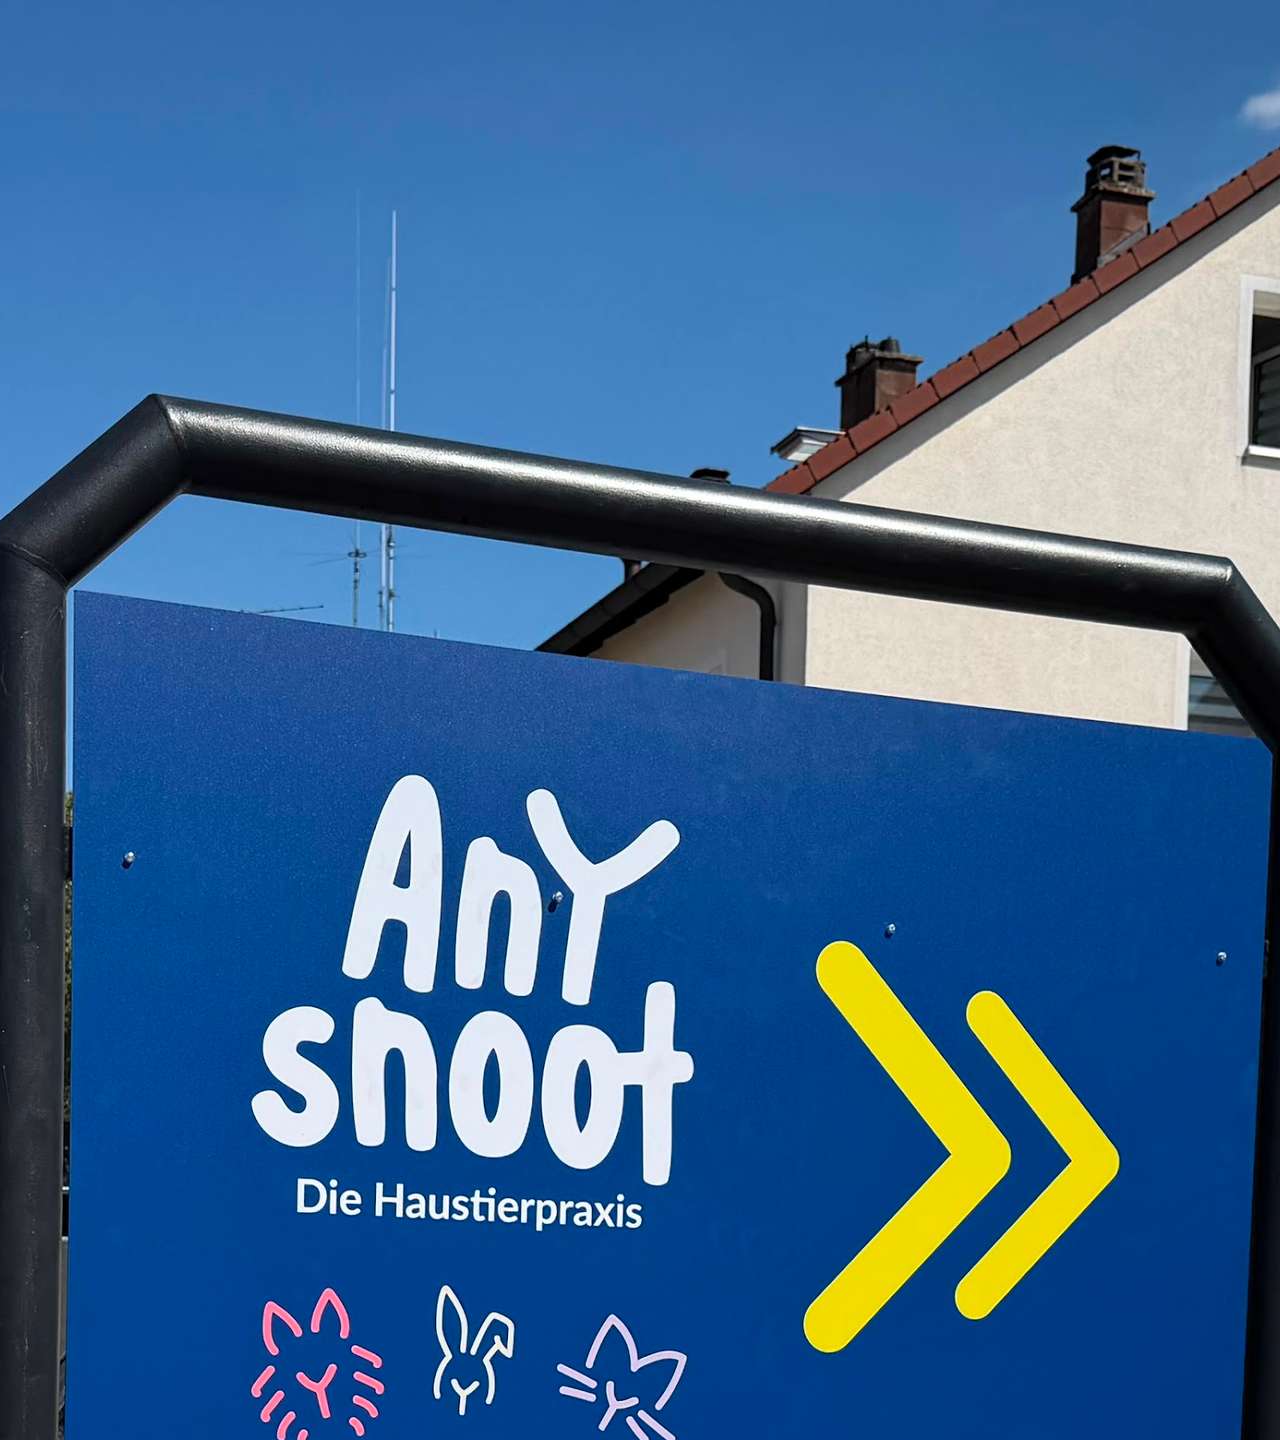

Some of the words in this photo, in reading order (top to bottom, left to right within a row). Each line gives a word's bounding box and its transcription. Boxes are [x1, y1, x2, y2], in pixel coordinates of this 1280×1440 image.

[251, 981, 695, 1186] snoot
[296, 1178, 362, 1216] Die
[375, 1182, 643, 1232] Haustierpraxis
